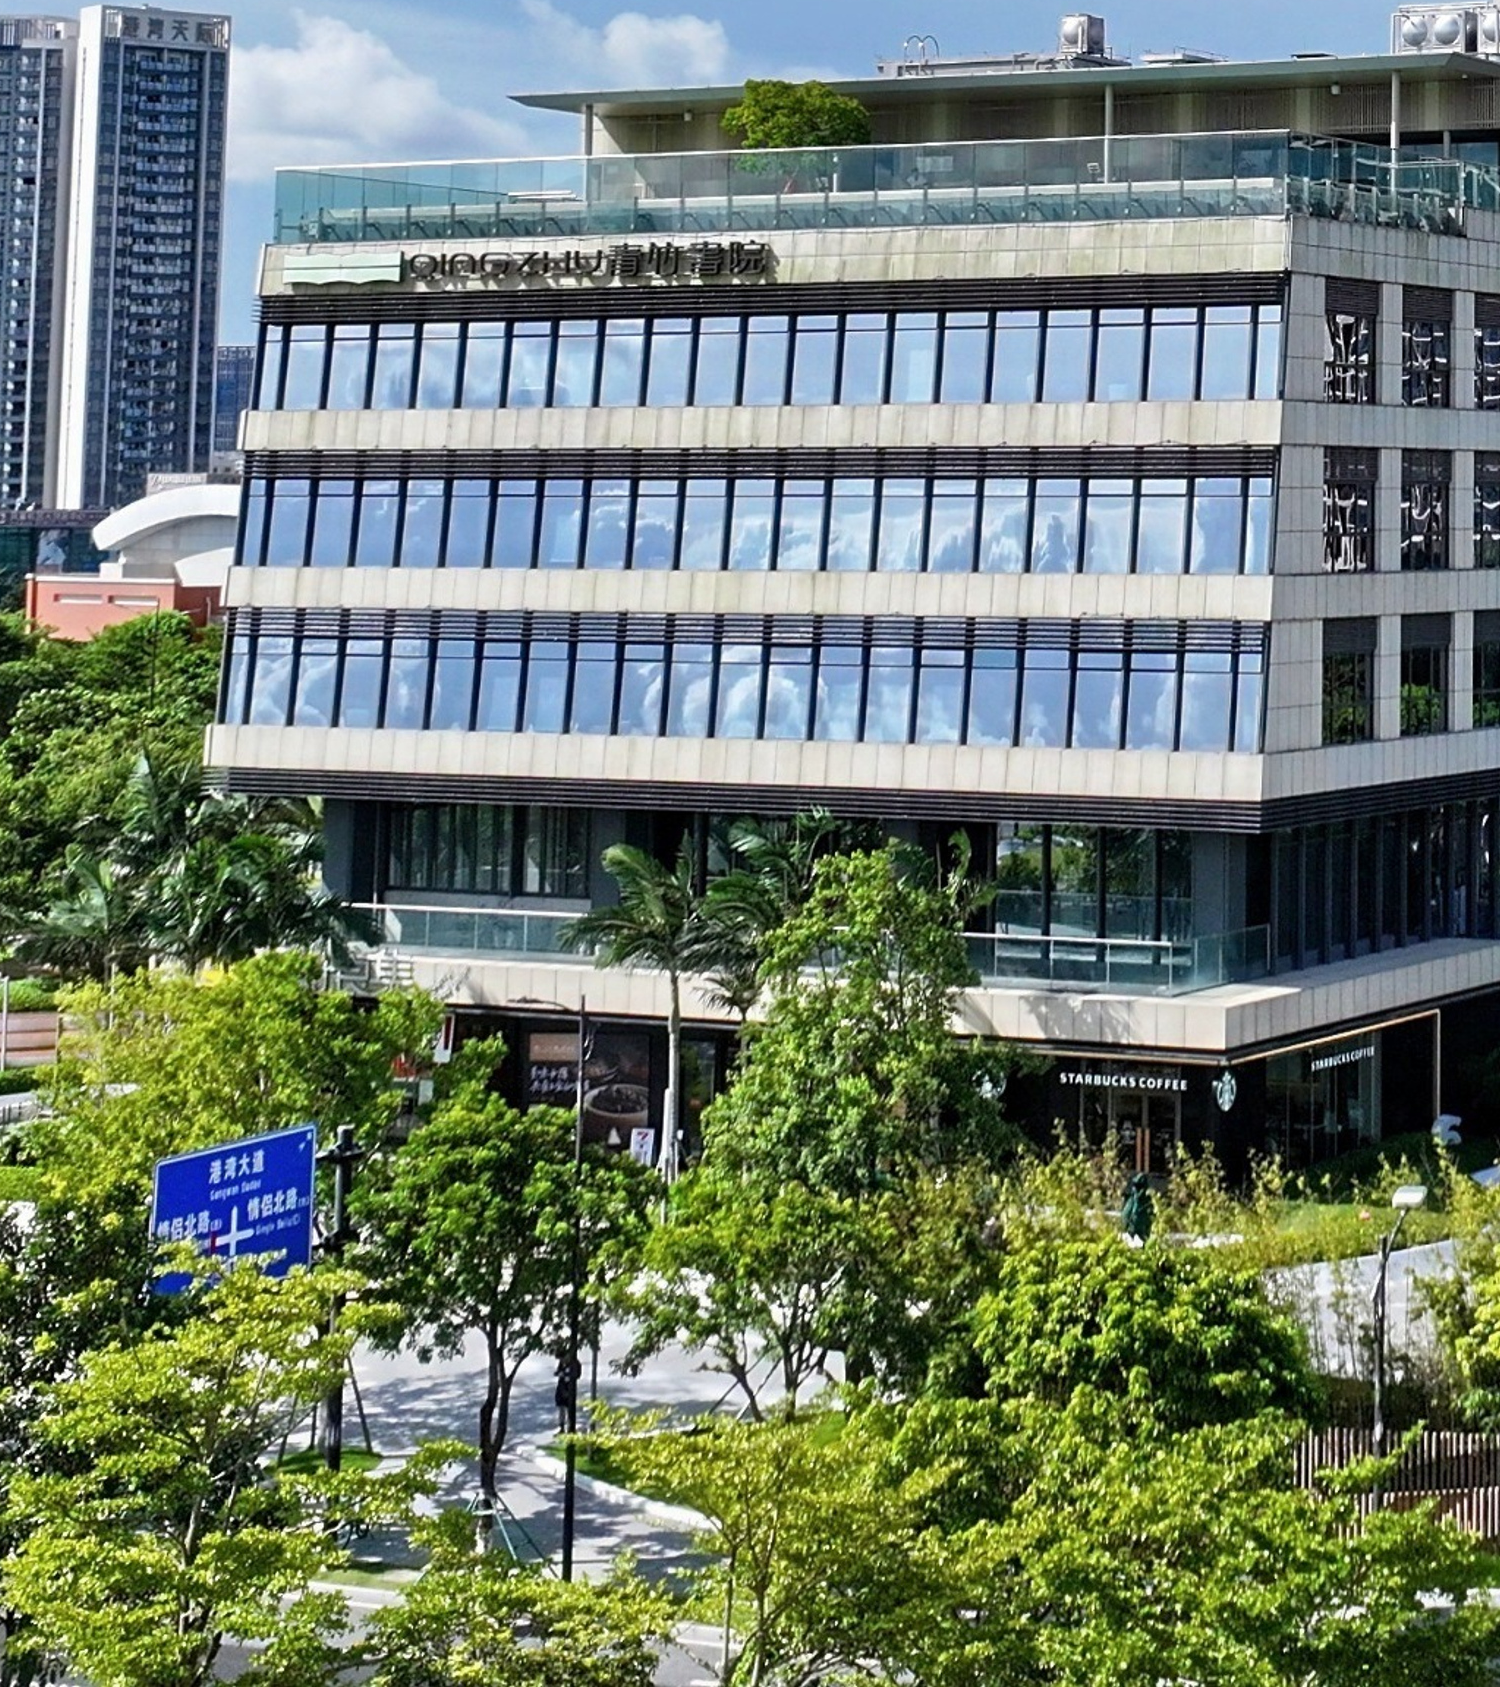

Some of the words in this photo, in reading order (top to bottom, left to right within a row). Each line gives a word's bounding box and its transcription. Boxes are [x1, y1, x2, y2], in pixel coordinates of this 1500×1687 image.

[609, 240, 767, 277] 青竹書院
[1059, 1072, 1137, 1088] STARBUCKS
[1138, 1077, 1188, 1091] COFFEE
[208, 1149, 265, 1184] 港湾大道
